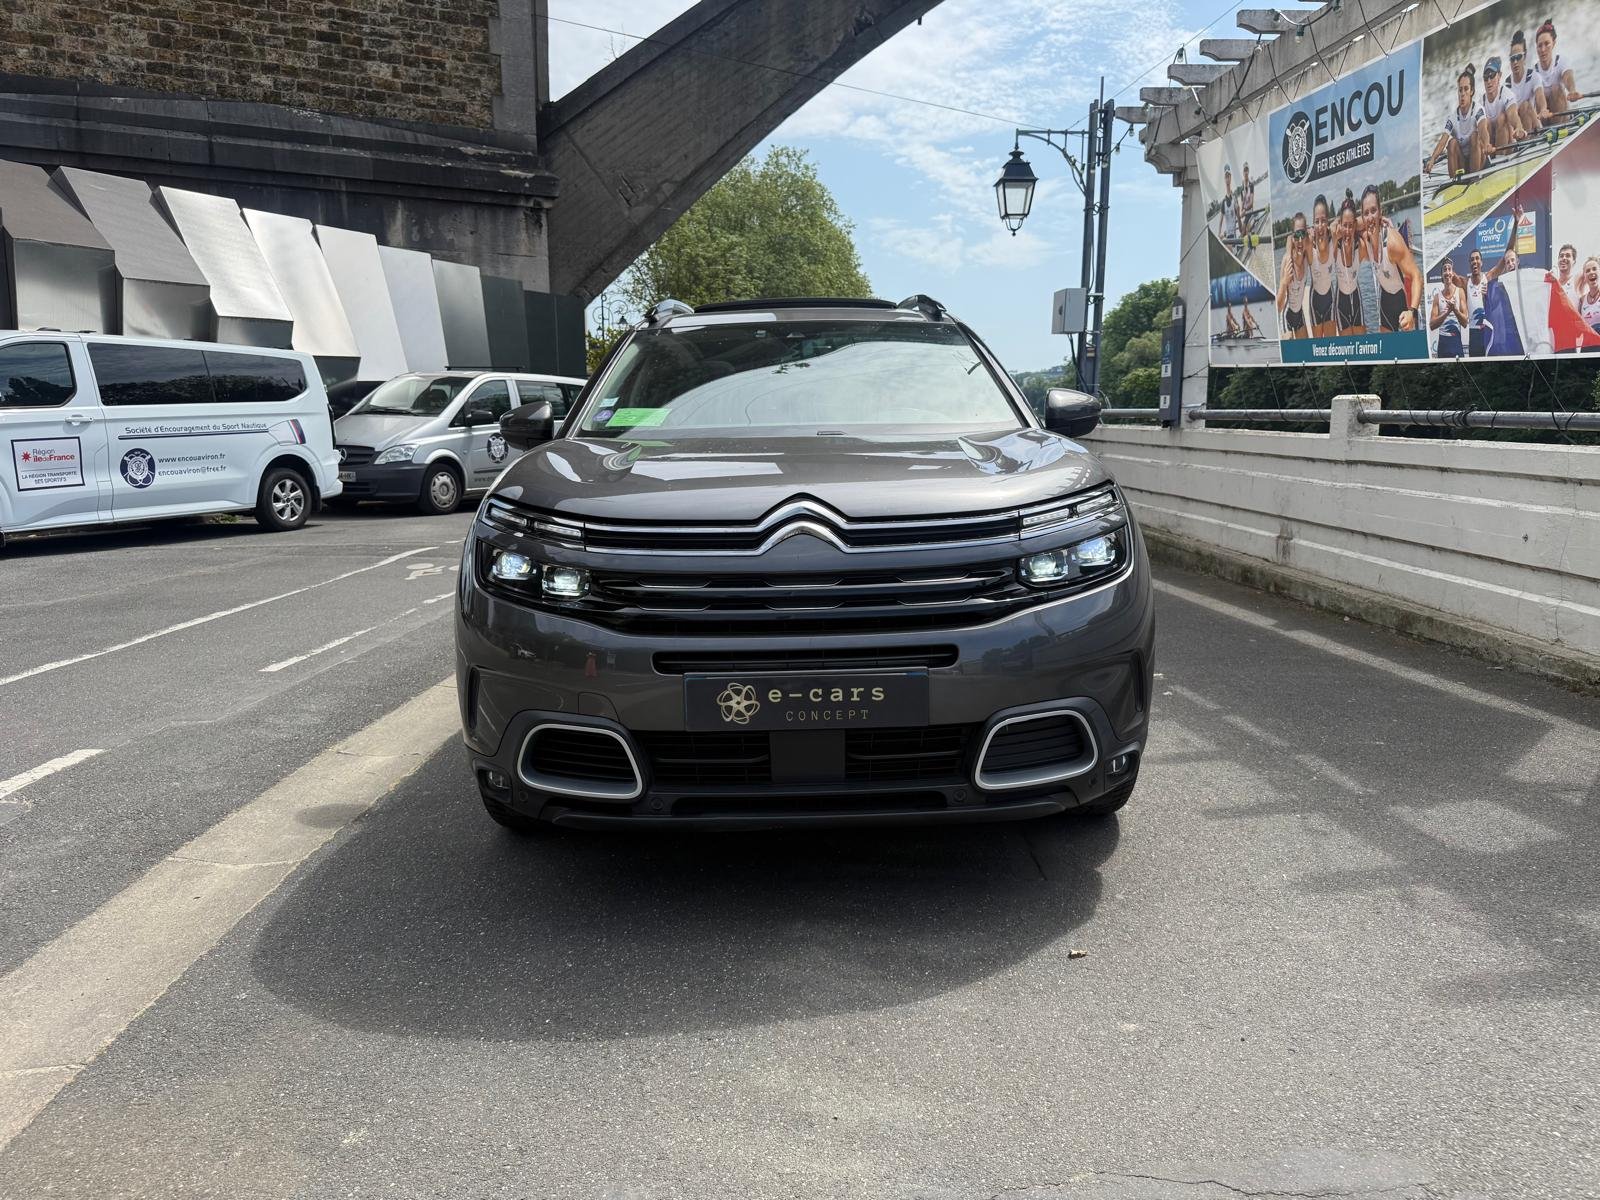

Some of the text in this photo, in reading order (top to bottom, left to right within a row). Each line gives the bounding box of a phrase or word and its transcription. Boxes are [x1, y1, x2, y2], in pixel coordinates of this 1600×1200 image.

[1314, 69, 1404, 147] ENCOU
[1317, 141, 1371, 173] FIER DE SES ATHLÈTES
[1478, 227, 1495, 237] world
[1312, 343, 1328, 357] Venez
[1328, 342, 1355, 356] découvrir
[1355, 341, 1378, 355] l'aviron
[125, 426, 152, 434] Société
[154, 424, 211, 434] d'Encouragement
[212, 423, 221, 431] du
[221, 422, 240, 431] Sport
[32, 448, 56, 456] Région
[158, 452, 226, 463] www.encouaviron.fr
[158, 465, 227, 477] encouaviron@free.fr
[768, 687, 885, 702] e-cars
[785, 709, 869, 721] CONCEPT
